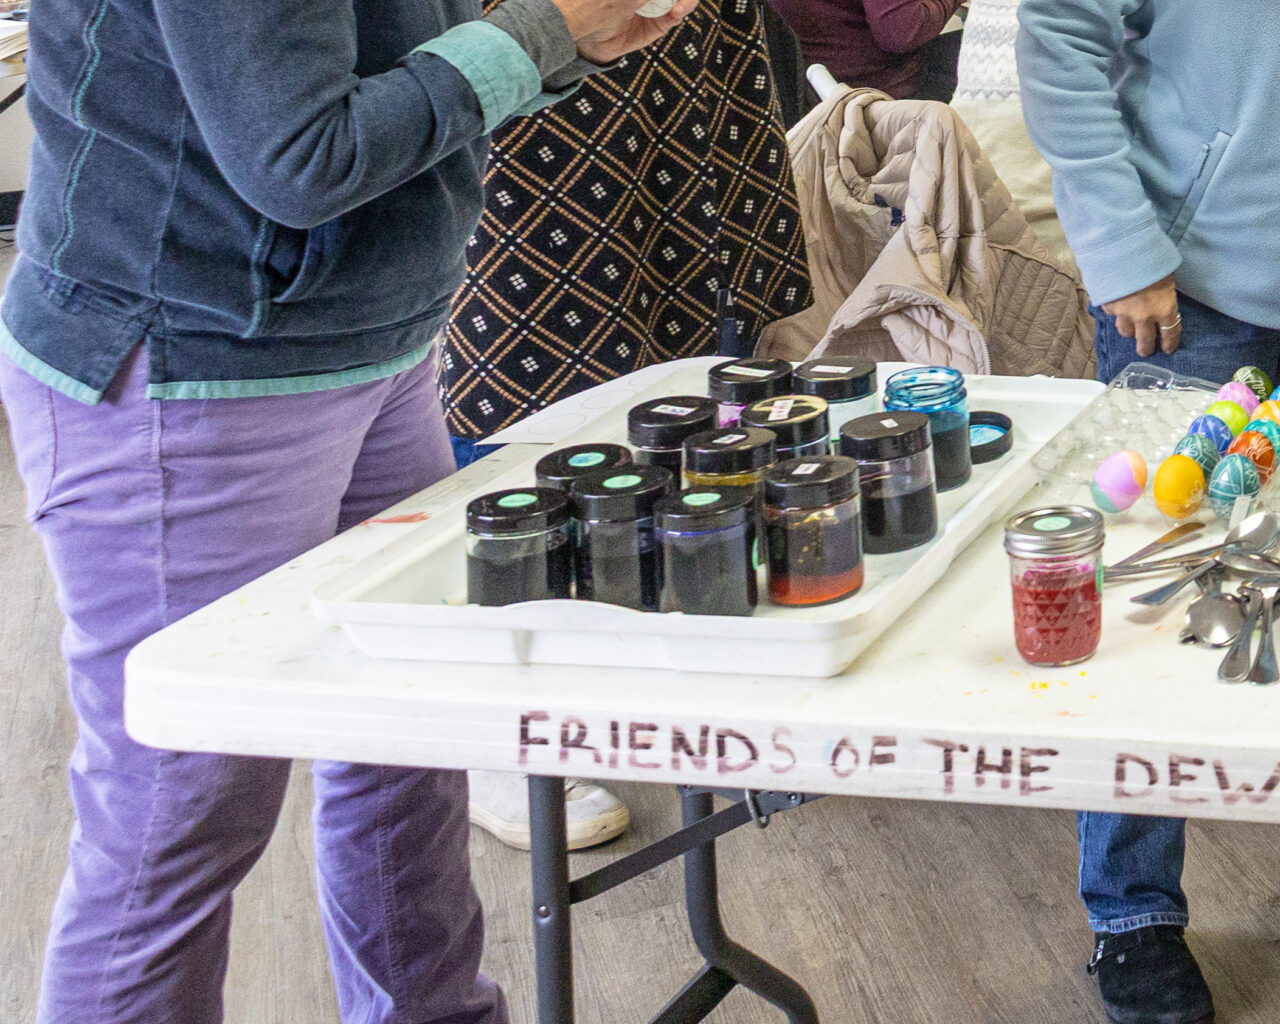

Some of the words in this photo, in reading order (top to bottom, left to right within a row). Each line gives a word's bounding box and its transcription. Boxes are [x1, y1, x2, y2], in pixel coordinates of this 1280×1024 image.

[518, 711, 797, 775] FRIENDS
[828, 735, 898, 779] OF
[920, 737, 1060, 795] THE
